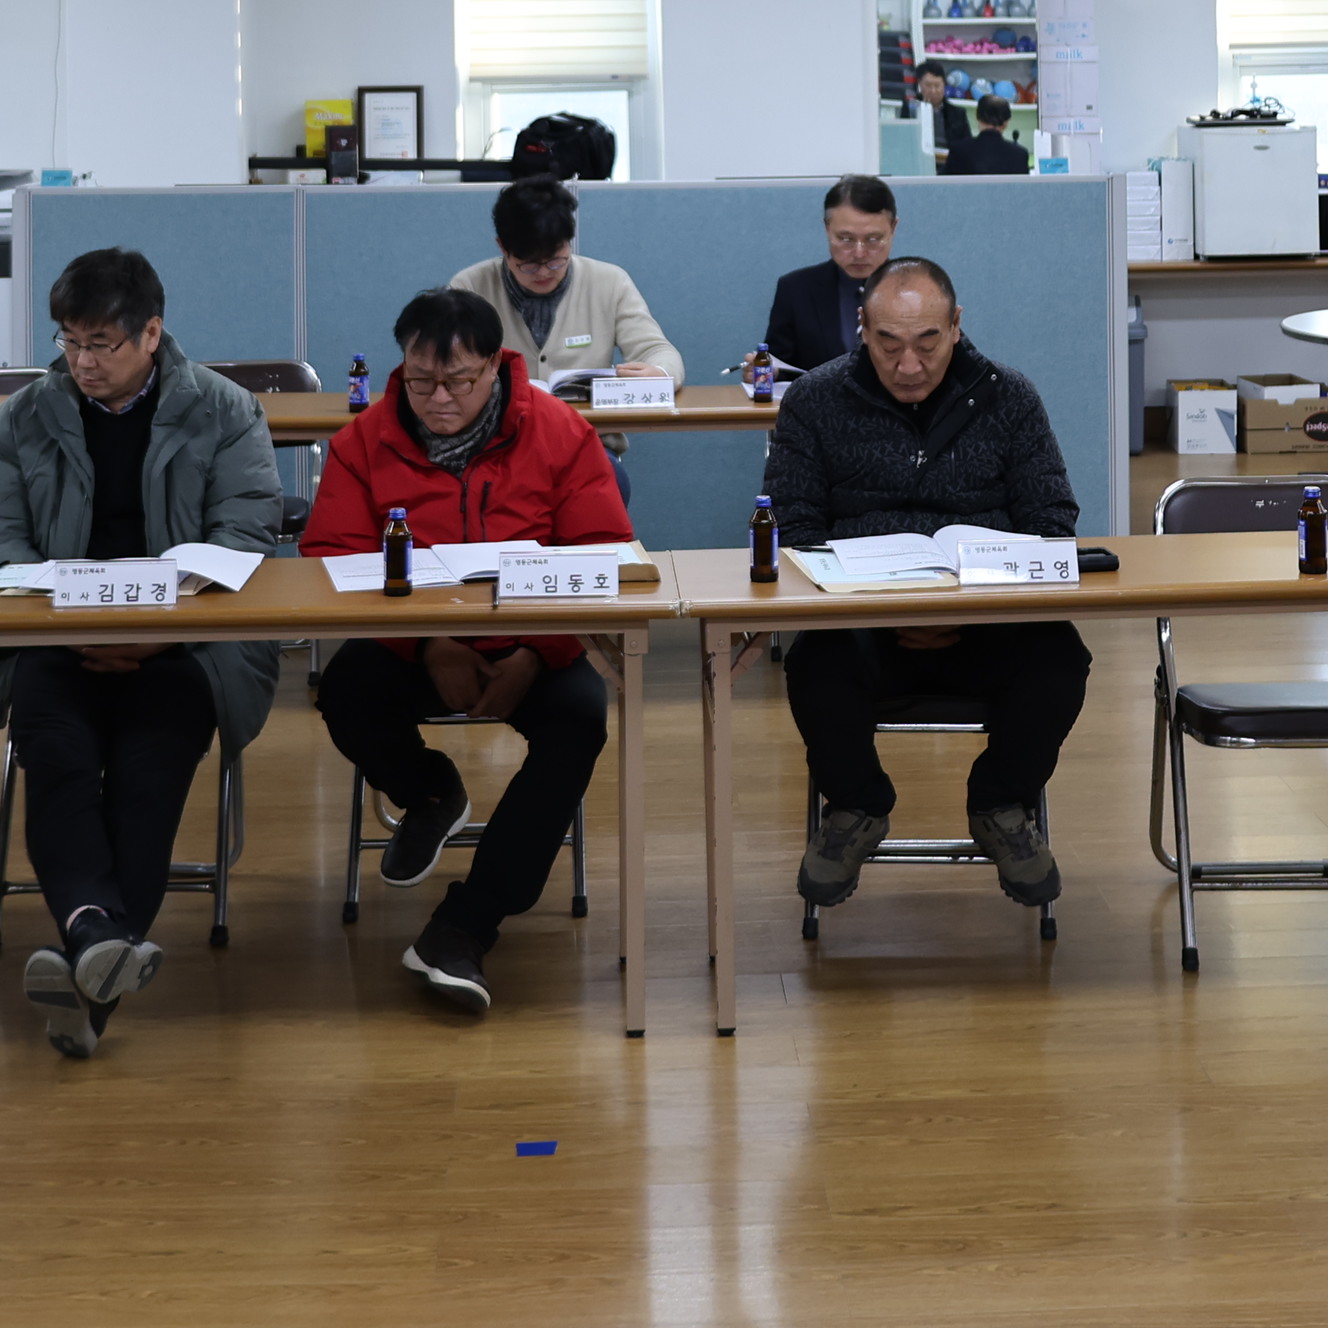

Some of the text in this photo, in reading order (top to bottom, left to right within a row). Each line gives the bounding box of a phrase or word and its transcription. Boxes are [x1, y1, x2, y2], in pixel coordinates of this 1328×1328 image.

[1055, 48, 1084, 60] milk
[1057, 120, 1085, 131] milk
[542, 574, 610, 593] 임동호
[98, 583, 167, 603] 김갑경
